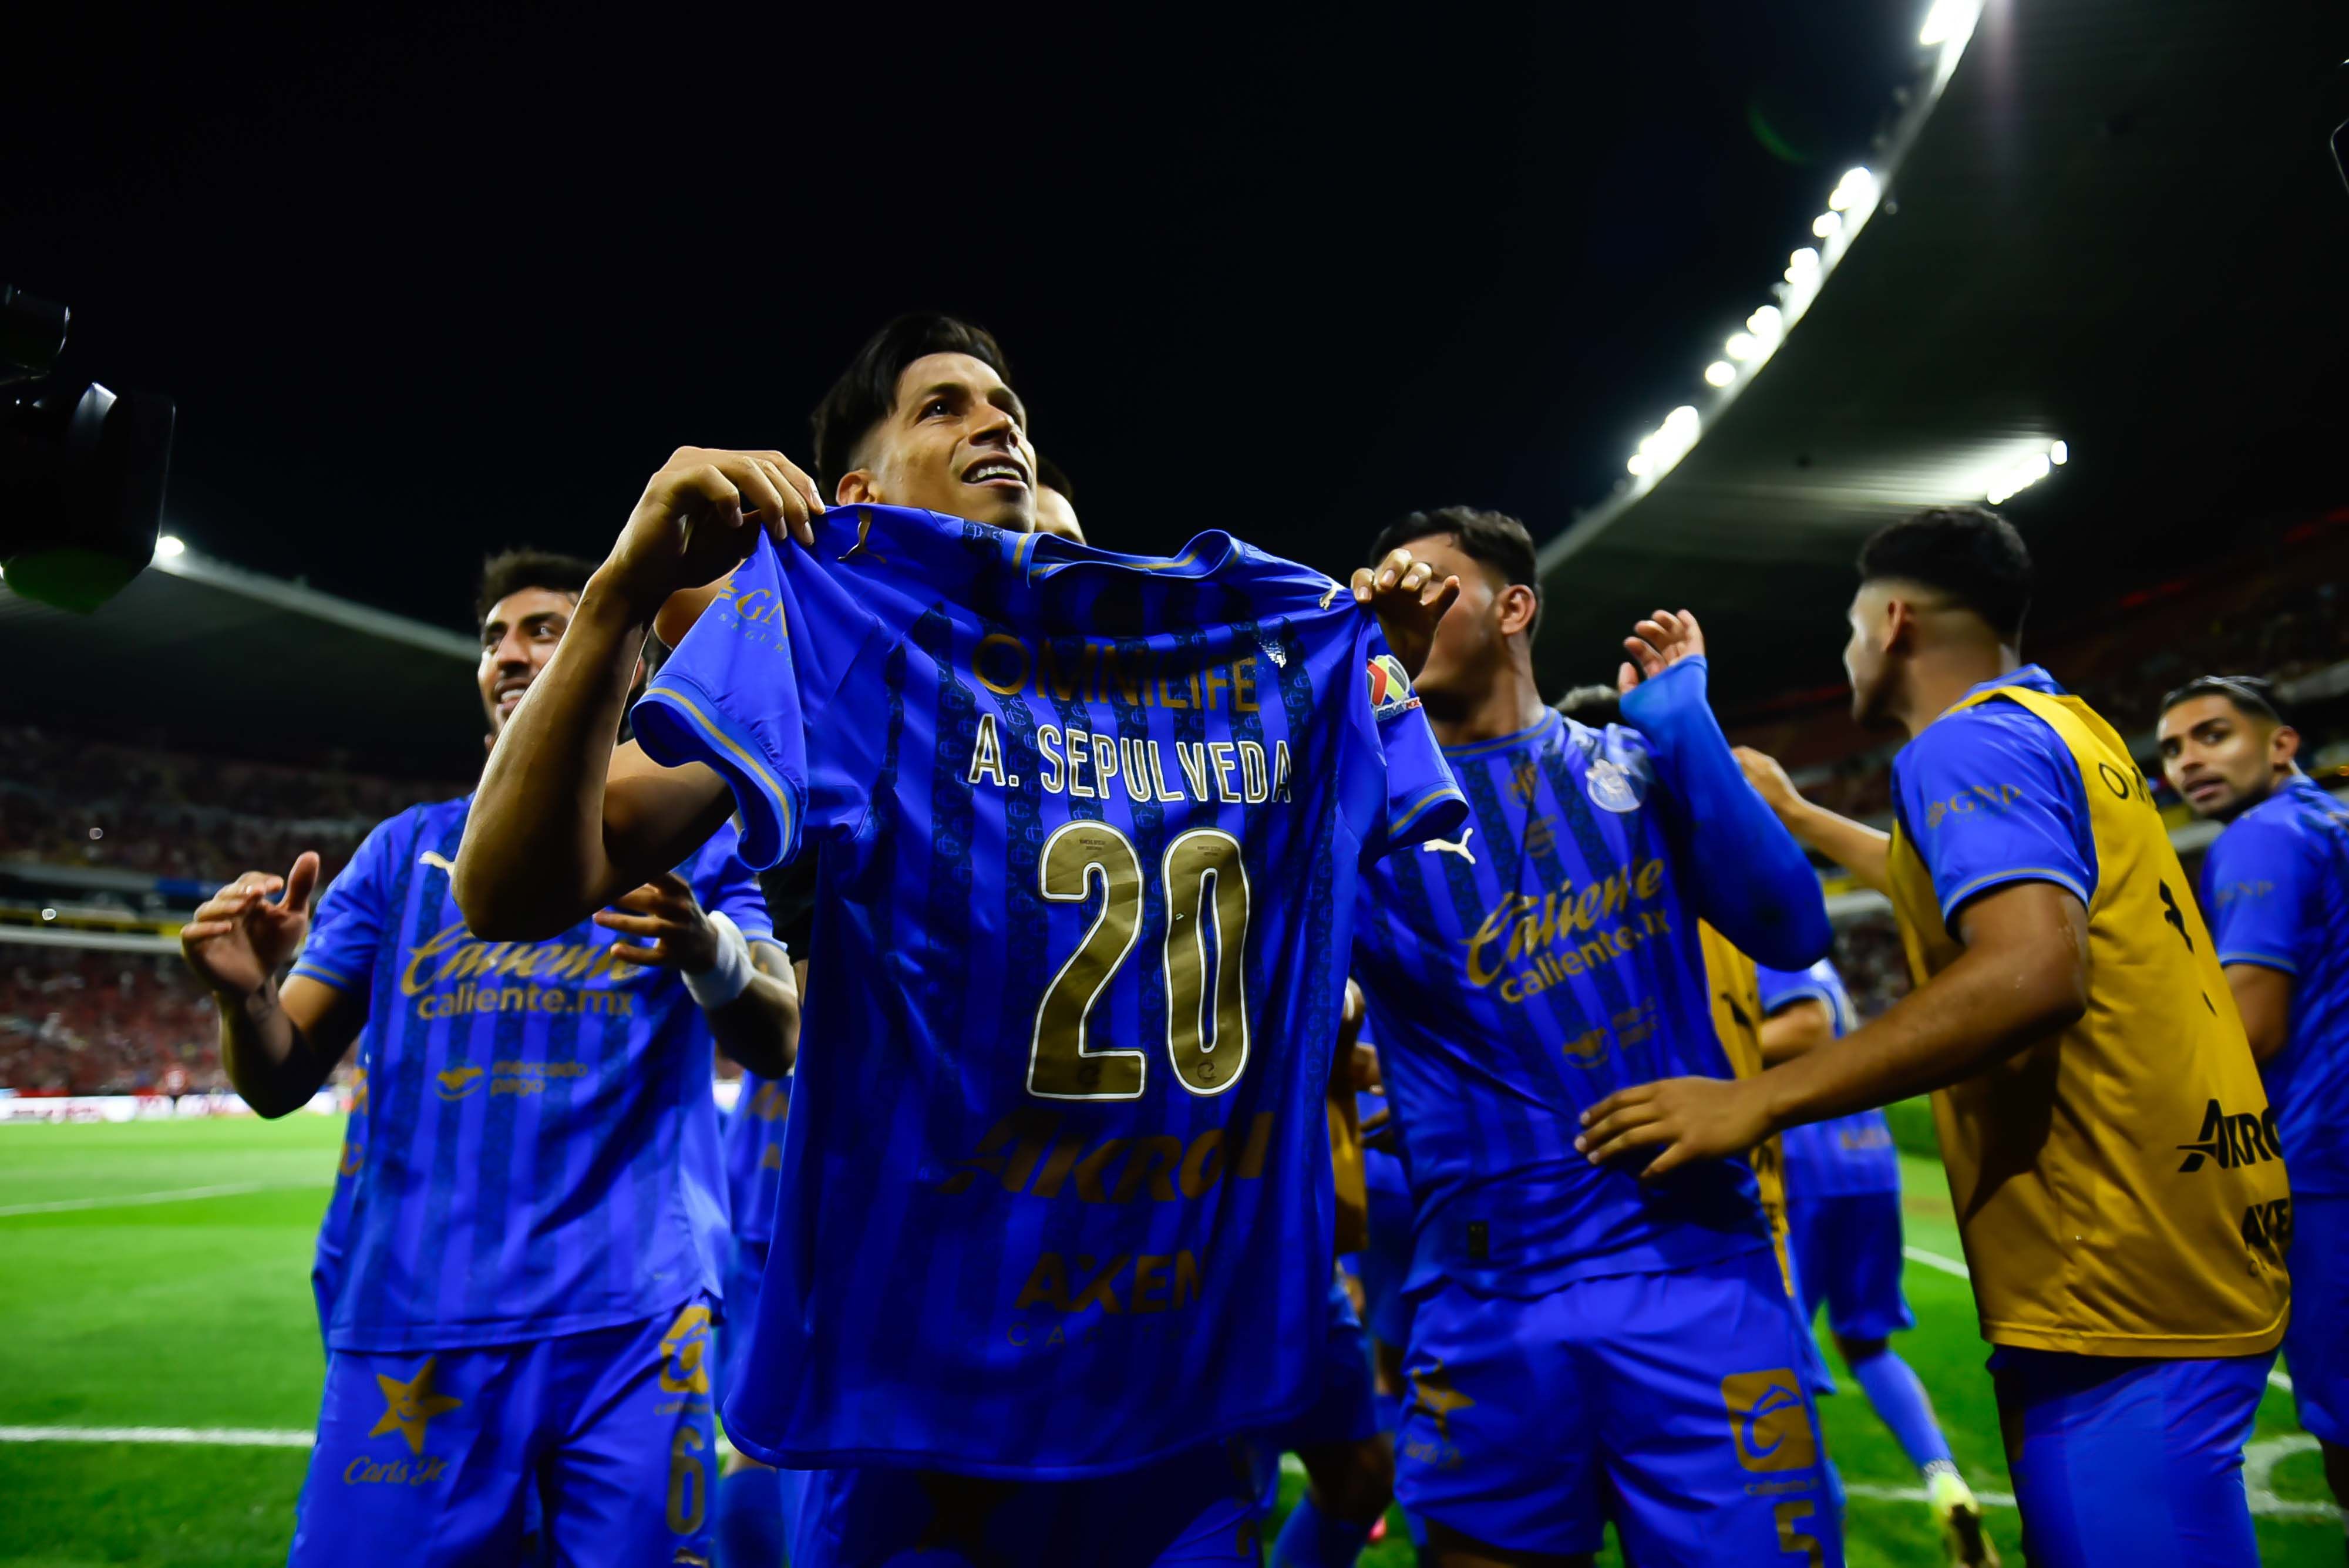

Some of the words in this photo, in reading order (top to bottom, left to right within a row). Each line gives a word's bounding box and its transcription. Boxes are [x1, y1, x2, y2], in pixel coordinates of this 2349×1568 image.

[968, 713, 1019, 787] A.
[1036, 724, 1291, 804] SEPULVEDA
[417, 981, 634, 1021] caliente.mx
[1026, 819, 1251, 1101] 20
[2176, 1099, 2283, 1172] AKRO
[2242, 1197, 2290, 1248] AXE
[665, 1426, 705, 1536] 6
